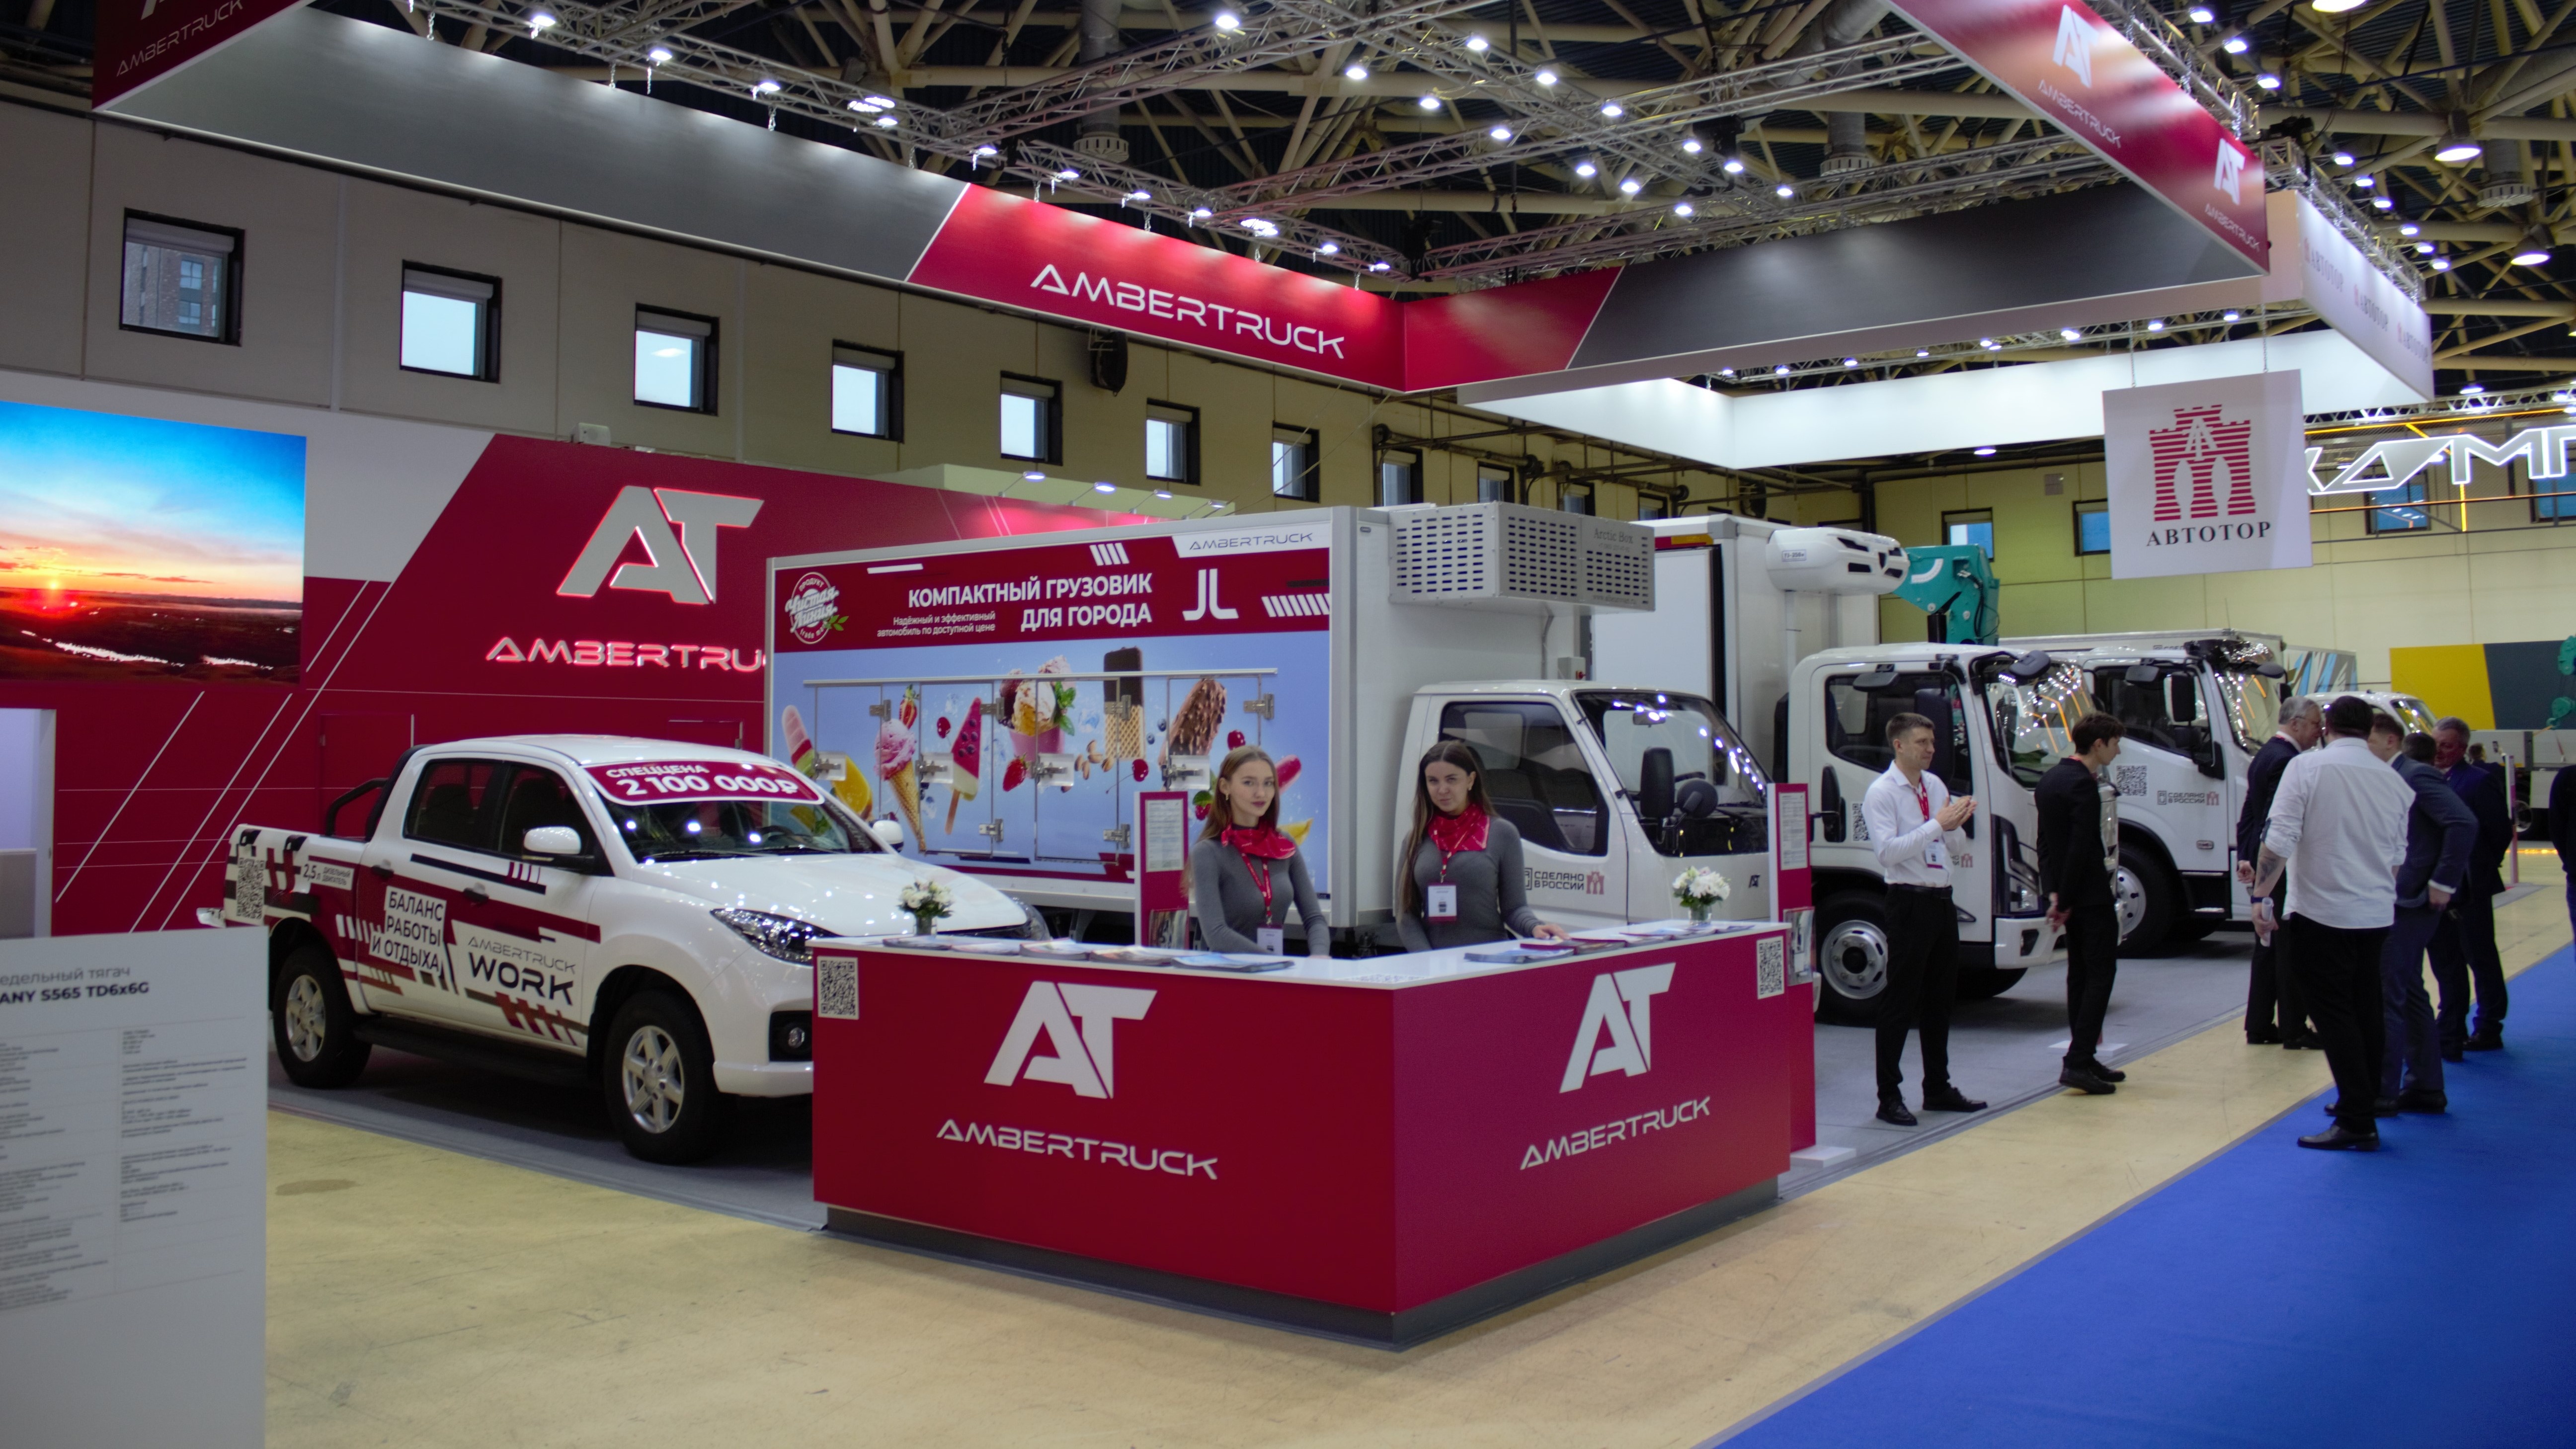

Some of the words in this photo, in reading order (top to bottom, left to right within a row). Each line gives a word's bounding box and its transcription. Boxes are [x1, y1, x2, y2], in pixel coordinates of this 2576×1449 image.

[116, 0, 243, 77] AMBERTRUCK
[2038, 80, 2121, 149] AMBERTRUCK
[2205, 203, 2261, 252] AMBERTRUCK
[1031, 264, 1344, 359] AMBERTRUCK
[557, 485, 764, 605] AT
[1190, 533, 1313, 551] AMBERTRUCK
[1594, 528, 1616, 542] Arctic
[1619, 531, 1633, 544] Box
[2146, 521, 2271, 547] АВТОТОР
[785, 586, 839, 617] Чистая
[908, 576, 1040, 608] КОМПАКТНЫЙ
[1046, 573, 1152, 599] ГРУЗОВИК
[790, 602, 838, 633] Линия
[877, 626, 921, 637] автомобиль
[932, 623, 974, 636] доступной
[975, 624, 996, 633] цене
[893, 614, 933, 626] Надёжный
[941, 611, 996, 625] эффективный
[1021, 608, 1062, 632] ДЛЯ
[1068, 603, 1152, 628] ГОРОДА
[486, 637, 766, 672] AMBERTRU
[606, 765, 710, 778] СПЕЦЦЕНА
[617, 779, 647, 795] 2
[646, 775, 710, 793] 100
[303, 864, 317, 881] 2,5
[323, 867, 351, 878] ДИЗЕЛЬНЫЙ
[1534, 871, 1585, 882] СДЕЛАНО
[1542, 880, 1584, 890] РОССИИ
[388, 891, 444, 922] БАЛАНС
[387, 915, 441, 947] РАБОТЫ
[371, 936, 381, 953] И
[384, 942, 440, 972] ОТДЫХА
[468, 936, 576, 974] AMBERTRUCK
[89, 966, 130, 980] тягач
[469, 952, 574, 1006] WORK
[41, 986, 81, 1001] S565
[85, 981, 149, 997] TD6x6G
[983, 980, 1157, 1099] AT
[1559, 962, 1676, 1094] AT
[1520, 1096, 1710, 1170] AMBERTRUCK
[937, 1119, 1218, 1180] AMBERTRUCK
